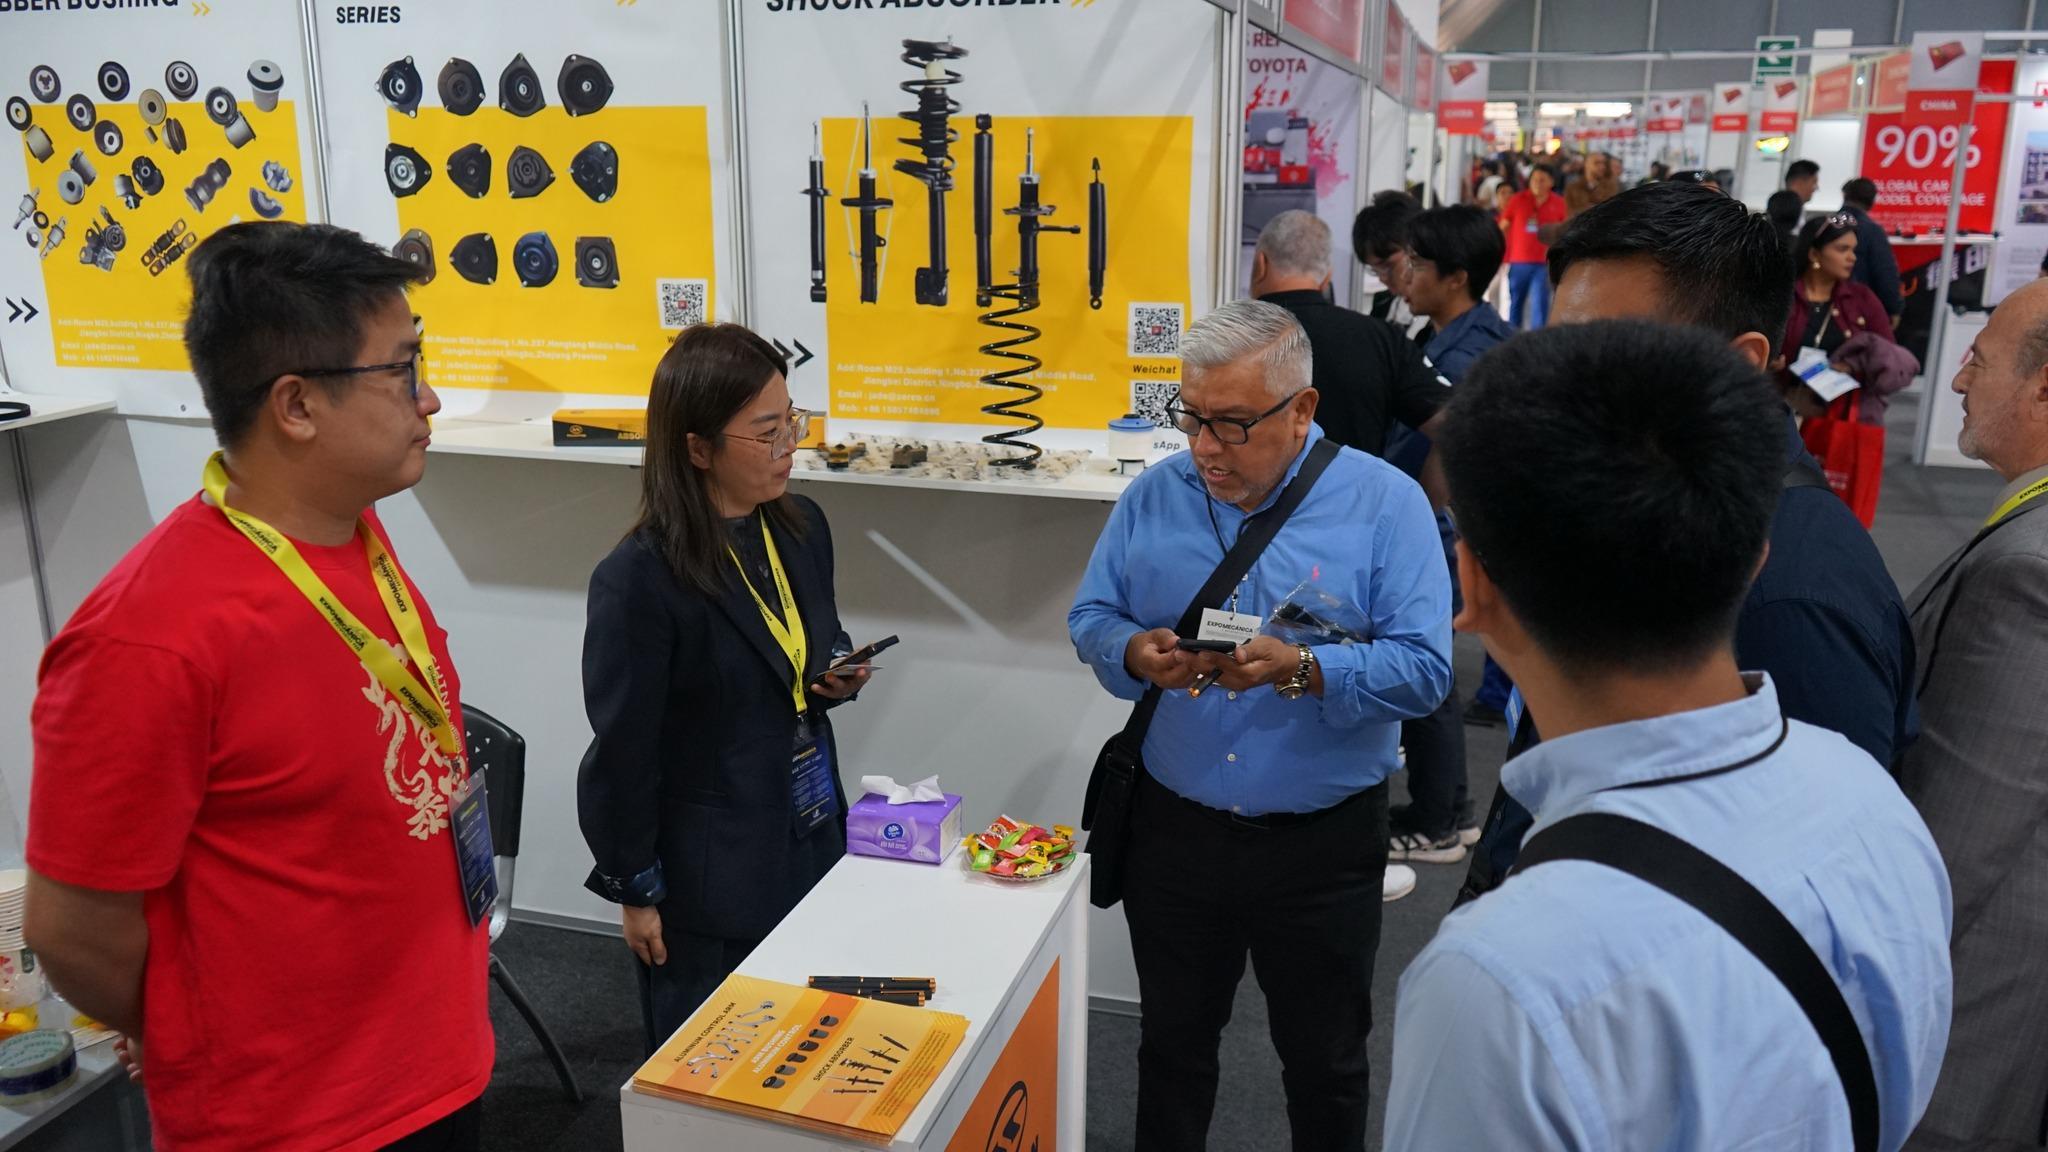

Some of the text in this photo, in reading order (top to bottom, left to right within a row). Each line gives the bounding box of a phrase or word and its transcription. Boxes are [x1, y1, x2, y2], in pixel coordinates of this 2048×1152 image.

[336, 6, 400, 24] SERIES
[1920, 99, 1957, 111] CHINA
[1876, 125, 1981, 169] 90%
[1922, 179, 1950, 192] CAR
[1915, 193, 1986, 206] COVEAGE
[1133, 364, 1177, 375] Weichat
[1153, 440, 1181, 451] sApp
[1207, 620, 1253, 633] EXPOMECÁNICA
[674, 1001, 737, 1063] ALUMINUM CONTROL ARM
[813, 1036, 855, 1082] SHOCK ABSORBER
